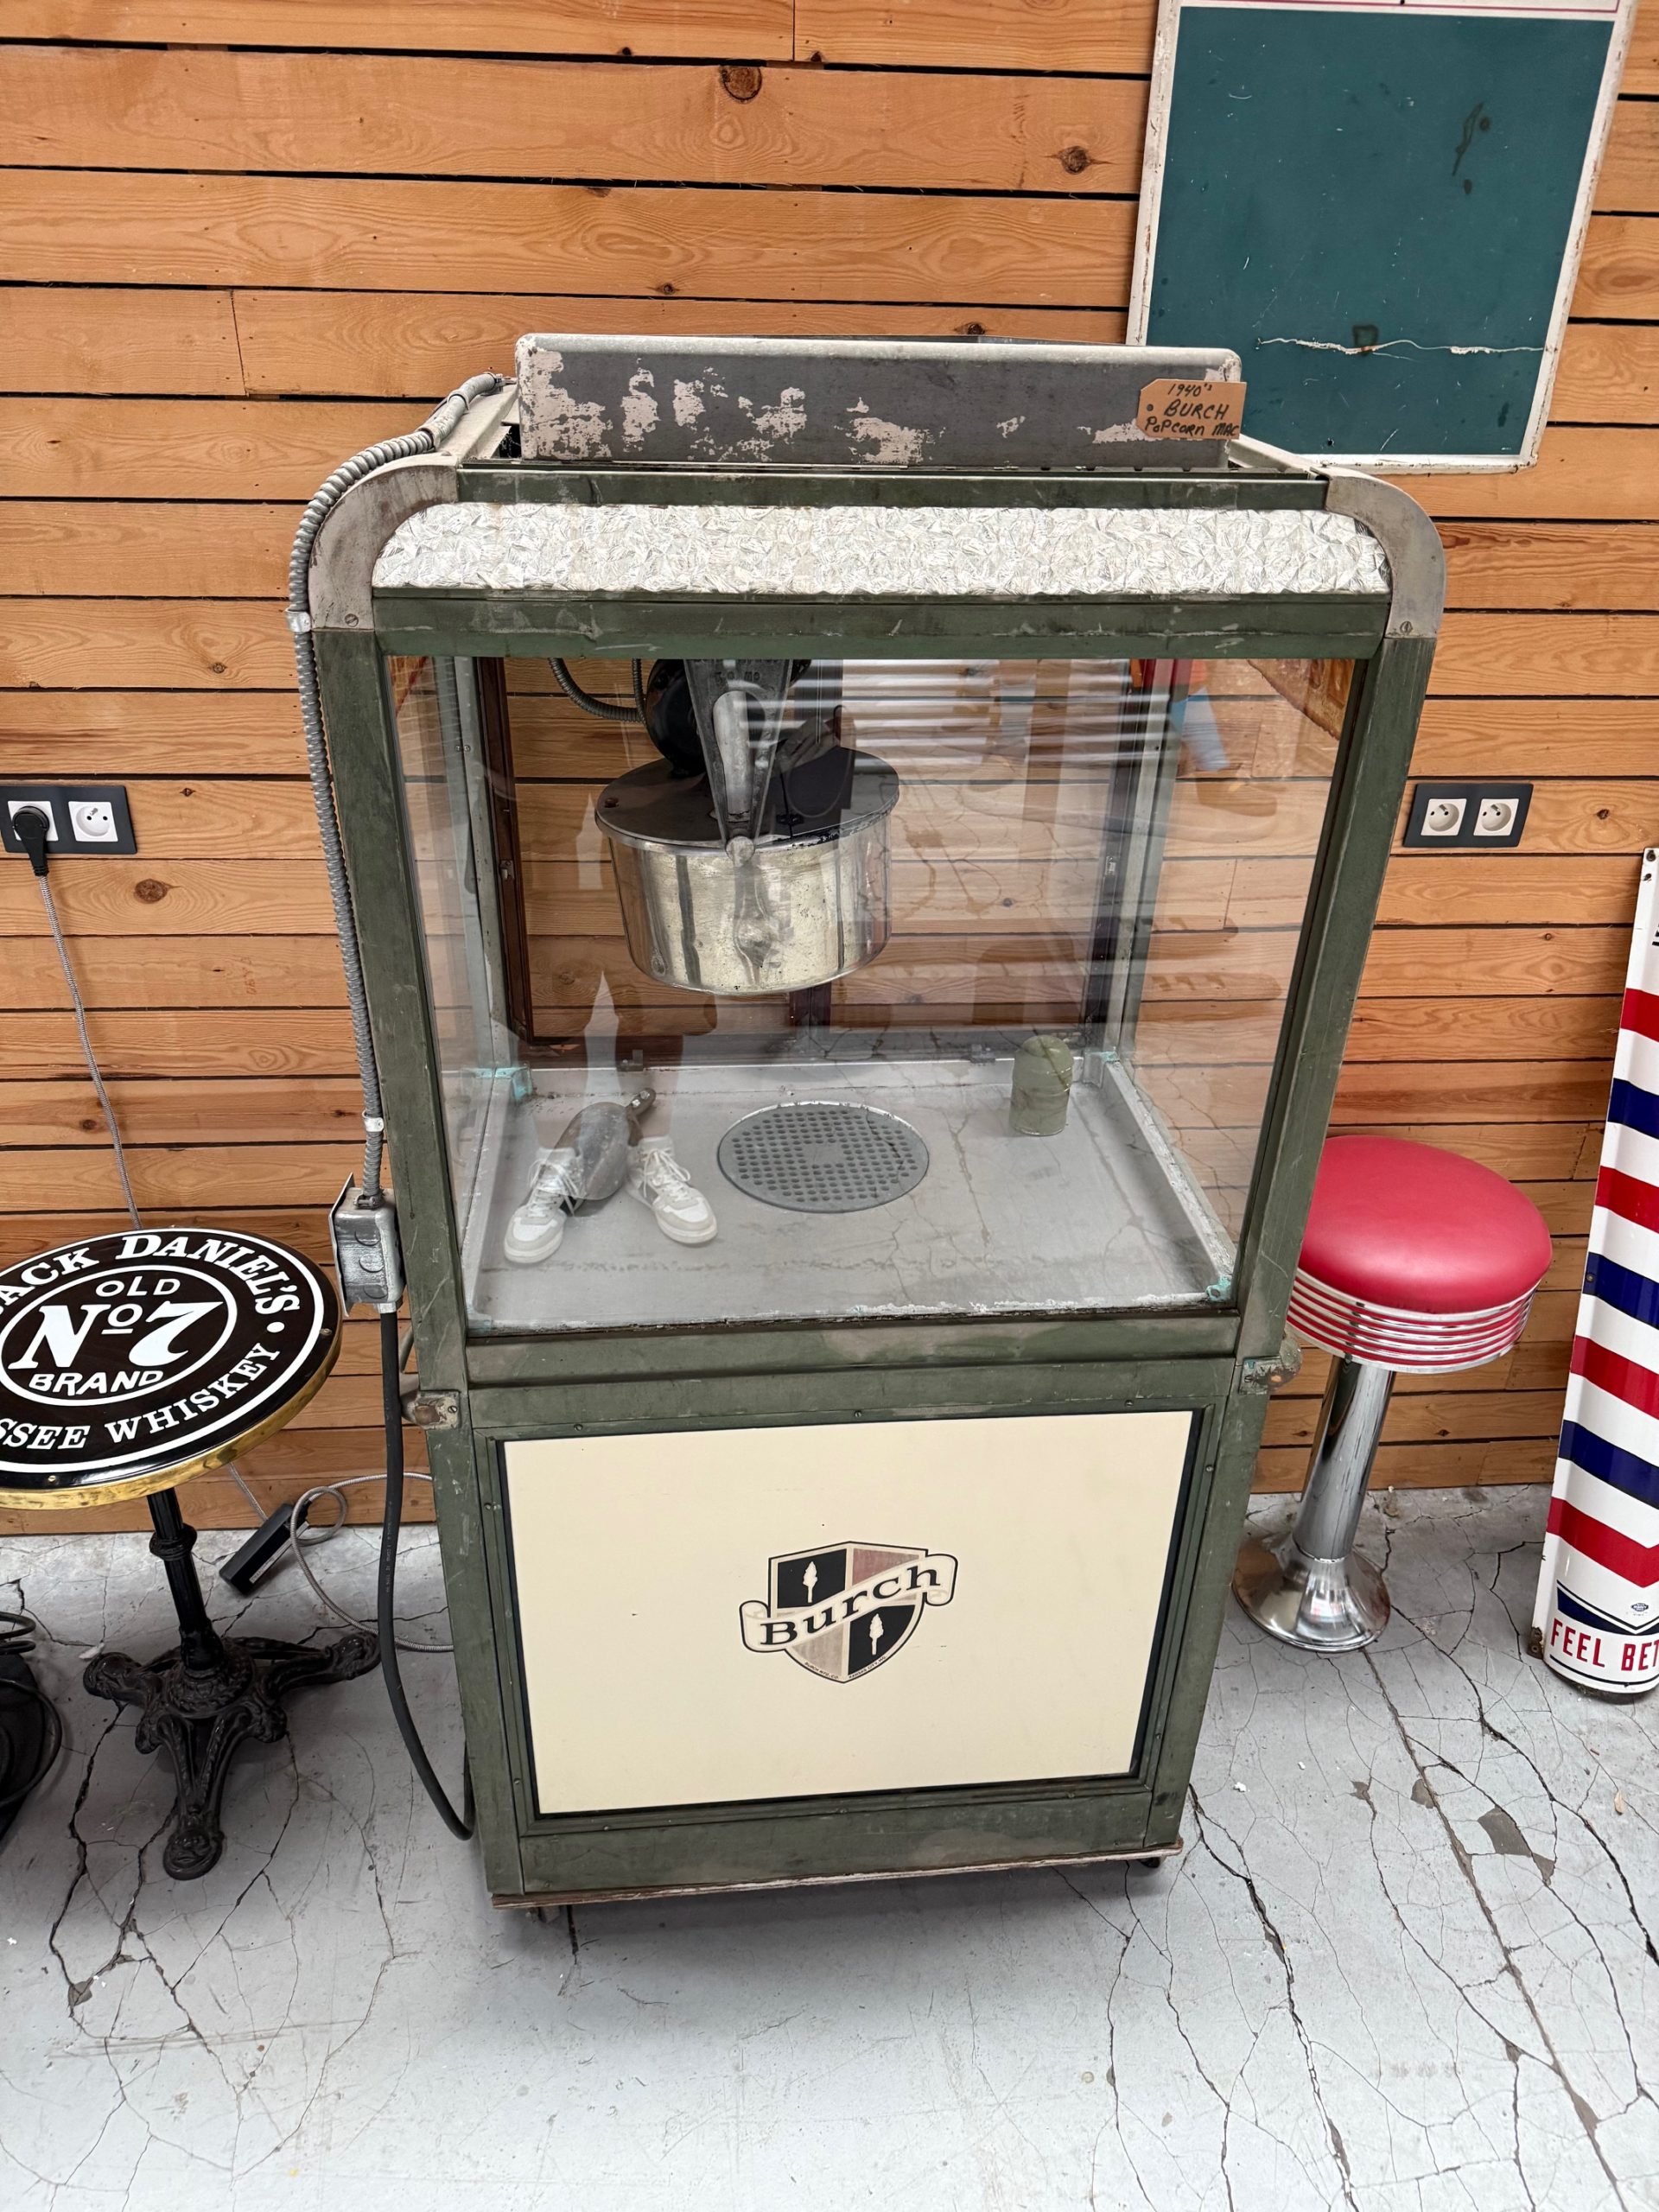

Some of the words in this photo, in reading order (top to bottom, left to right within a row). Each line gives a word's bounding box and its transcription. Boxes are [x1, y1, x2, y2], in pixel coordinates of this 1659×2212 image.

[1164, 398, 1230, 420] BURCH
[1168, 383, 1212, 397] 1940's
[0, 1248, 99, 1315] ACK
[115, 1234, 300, 1315] DANIEL'S
[96, 1276, 181, 1297] OLD
[128, 1300, 224, 1367] 7
[29, 1370, 164, 1396] BRAND
[104, 1343, 281, 1444] WHISKEY
[760, 1565, 940, 1645] Burch
[1550, 1618, 1605, 1668] FEEL
